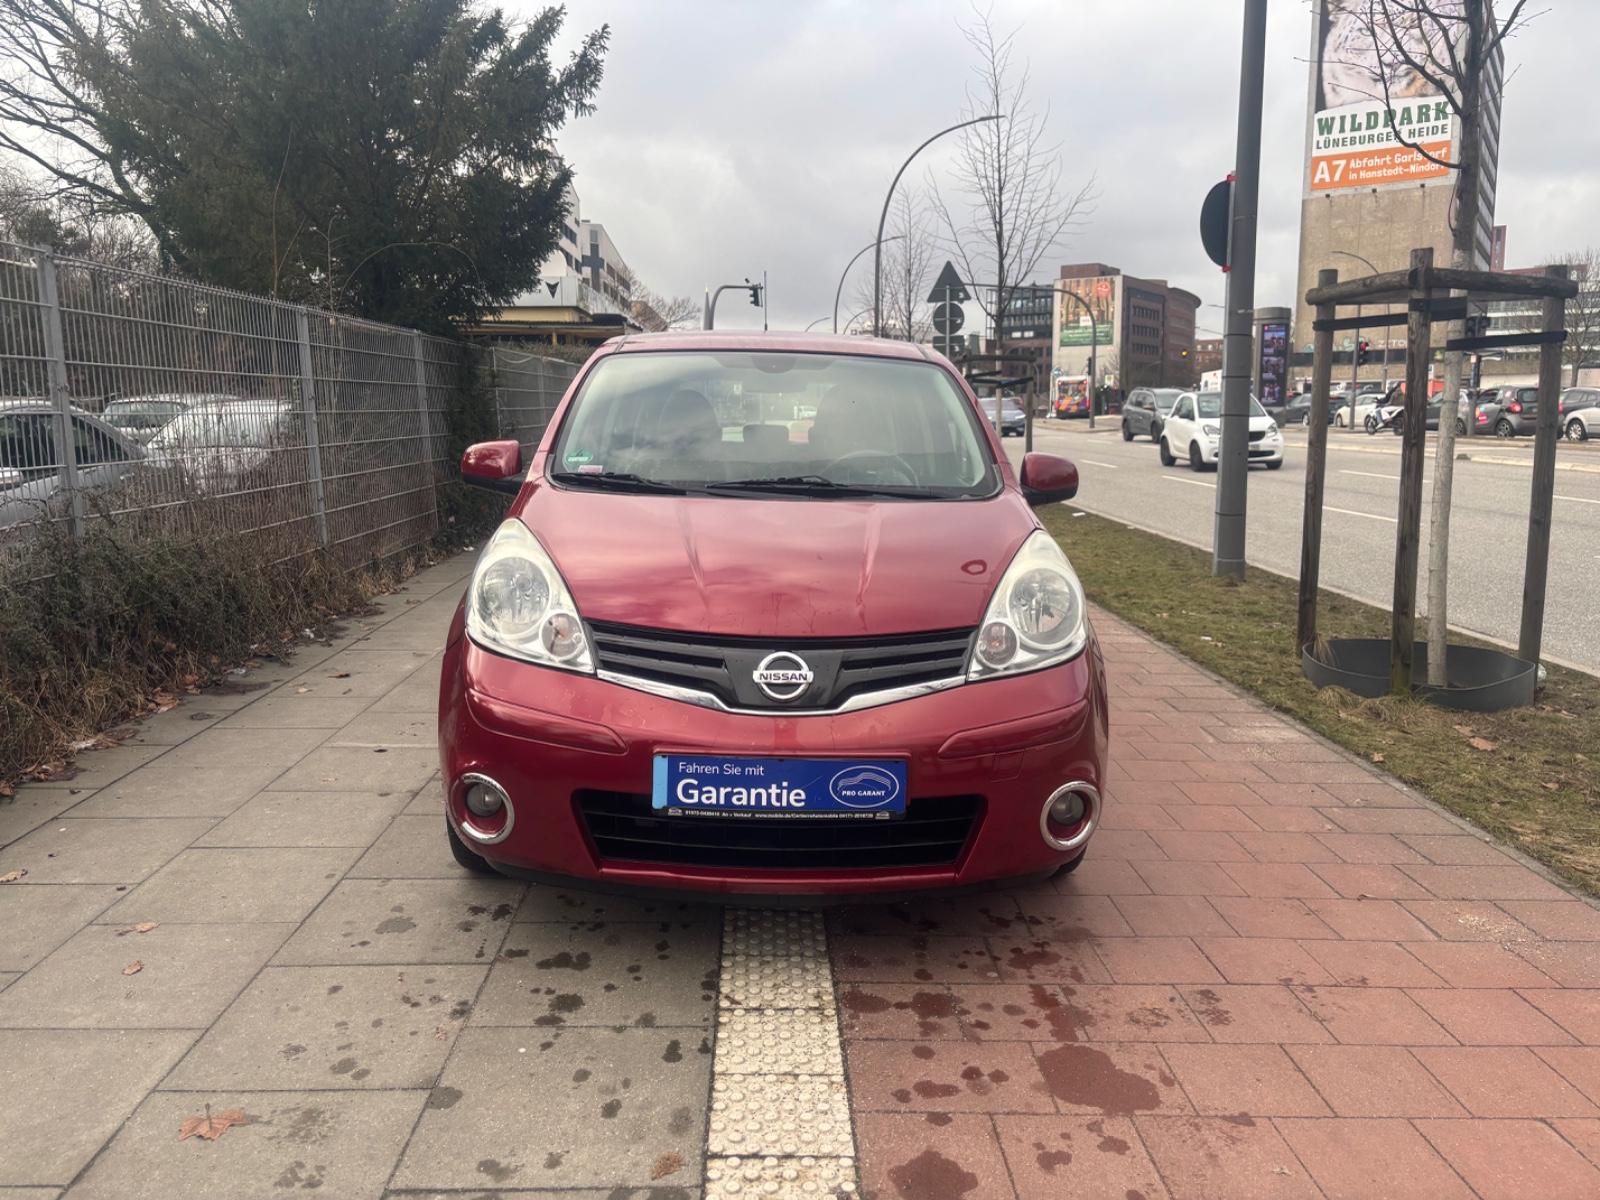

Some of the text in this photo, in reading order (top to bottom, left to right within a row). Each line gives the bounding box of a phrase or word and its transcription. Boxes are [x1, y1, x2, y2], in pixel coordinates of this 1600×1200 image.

[1317, 101, 1449, 136] WILDPARK
[1408, 123, 1449, 139] HEIDE
[1349, 147, 1448, 169] Abfahrt Garlsorf
[1314, 160, 1347, 184] A7
[1348, 161, 1444, 180] in Hanstedt-Nindor
[759, 672, 808, 681] NISSAN
[678, 762, 765, 776] Fahren Sie mit
[676, 778, 807, 808] Garantie
